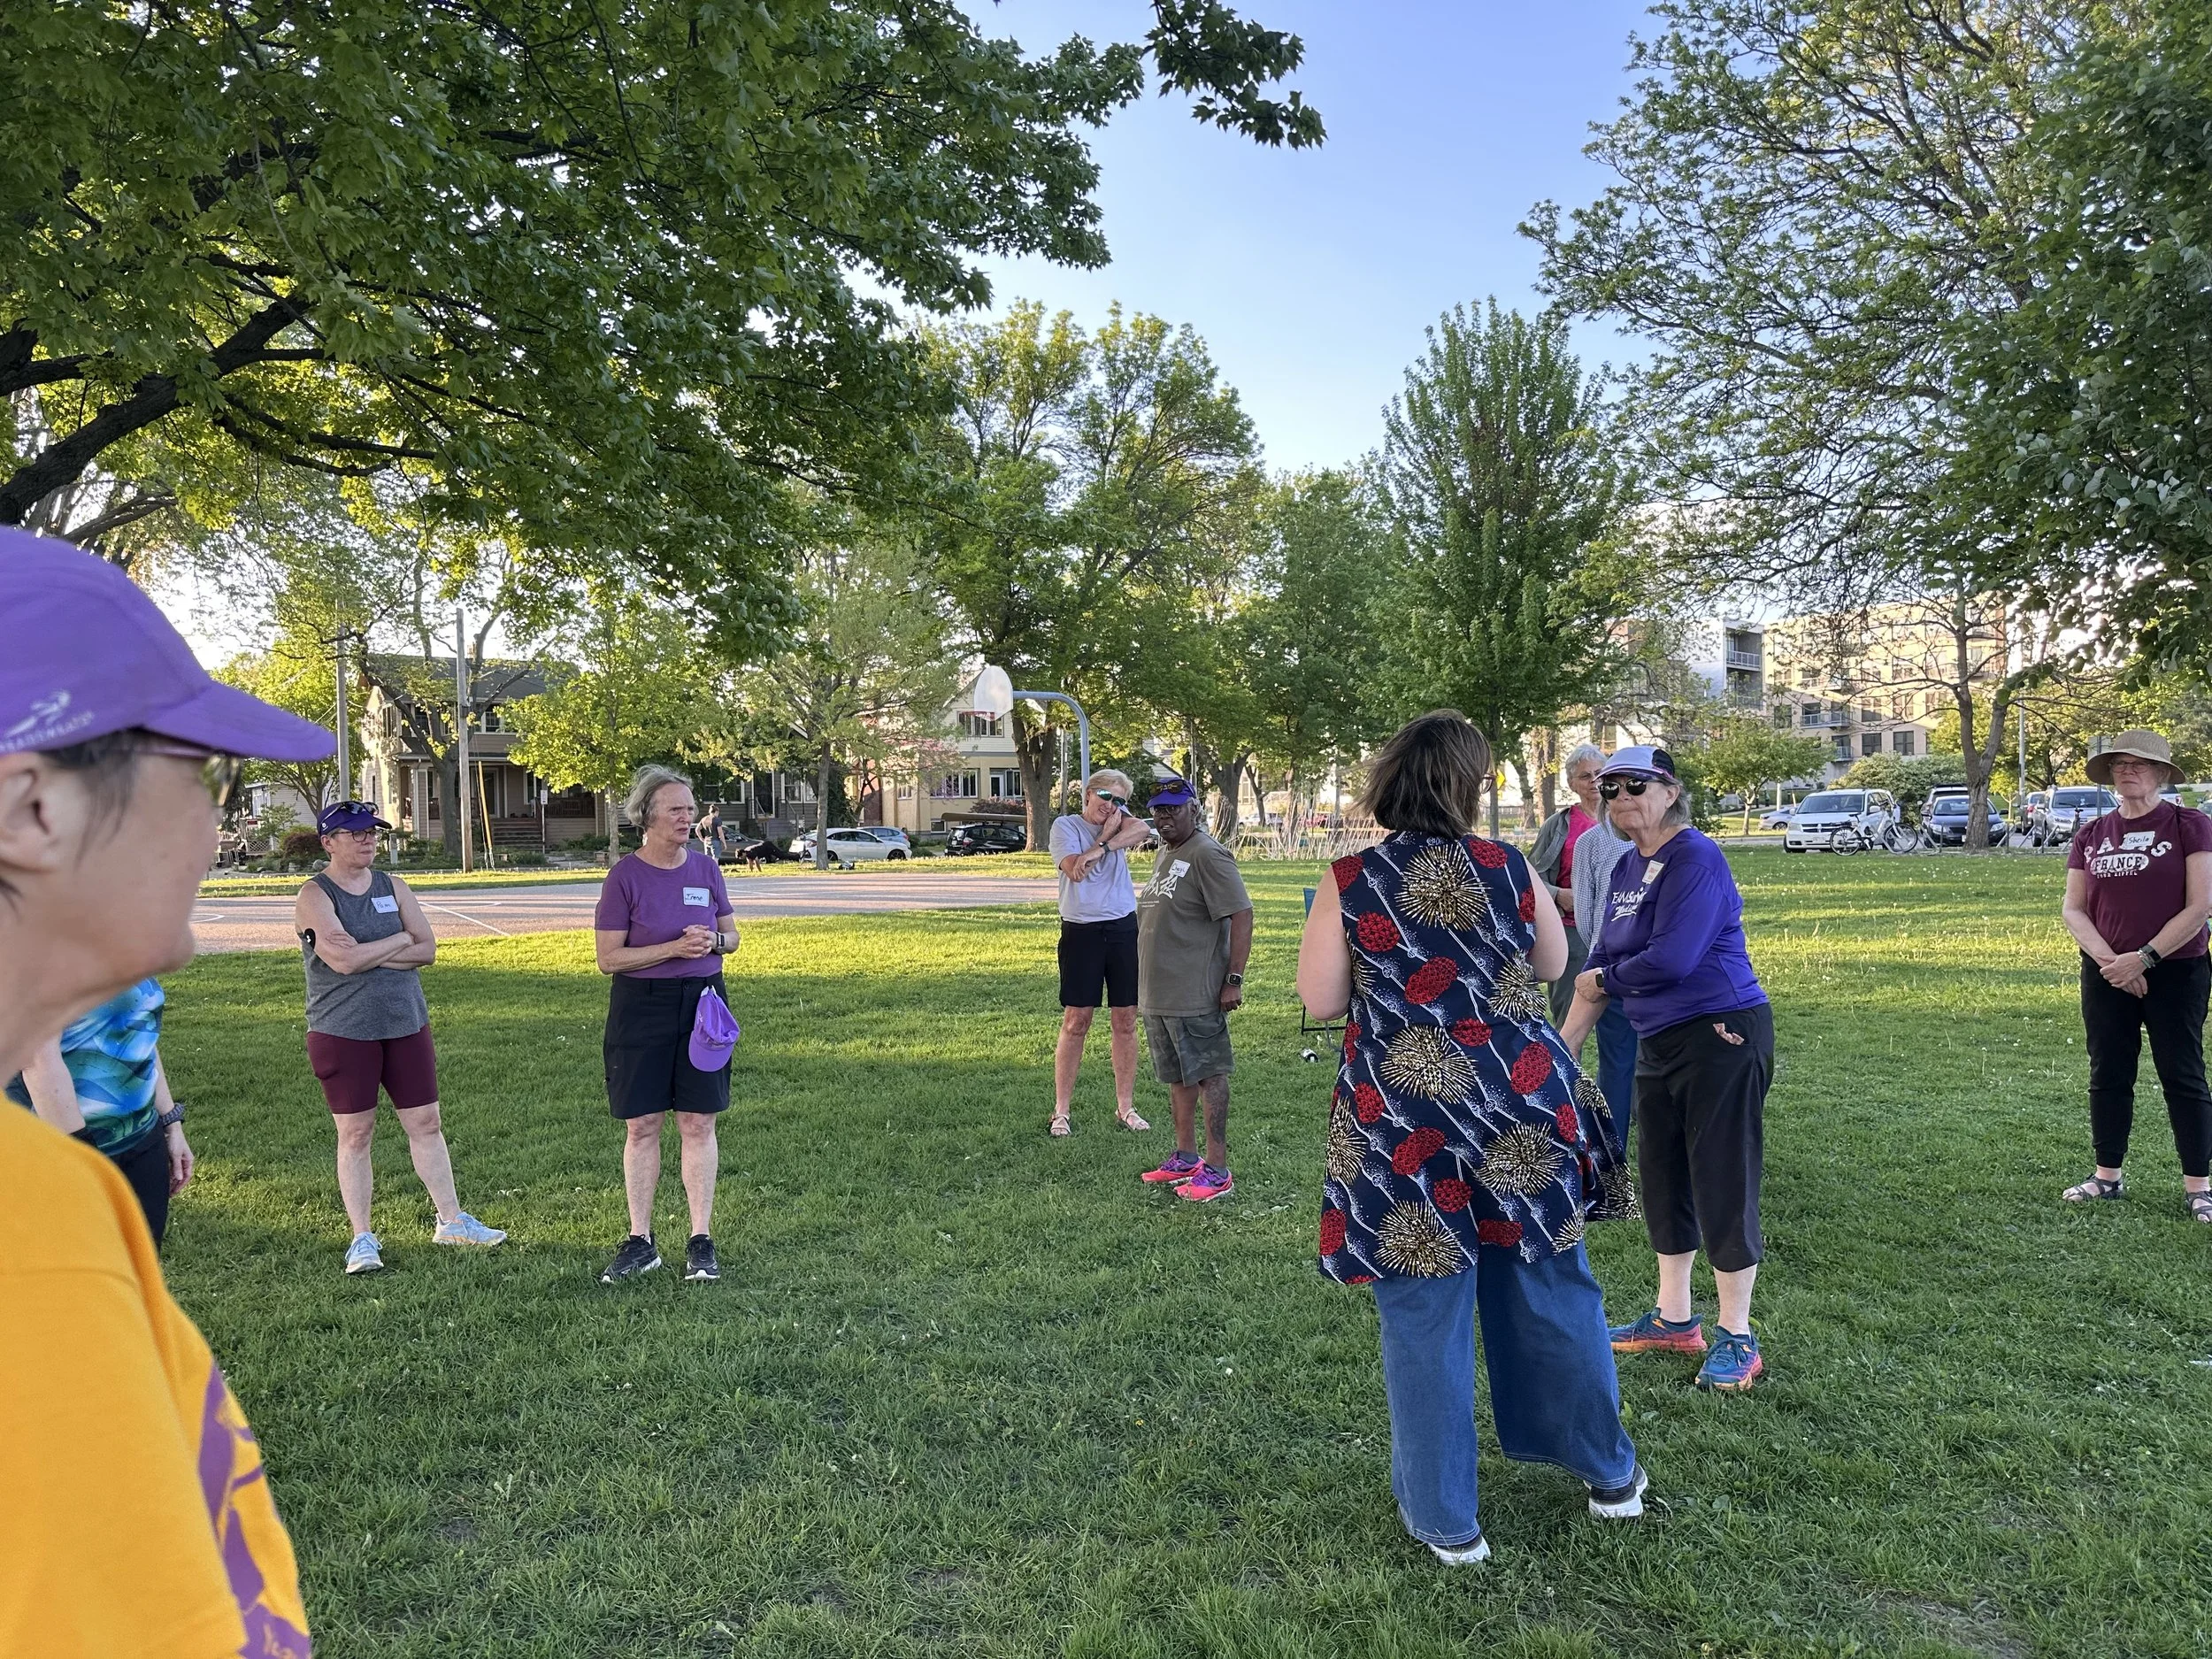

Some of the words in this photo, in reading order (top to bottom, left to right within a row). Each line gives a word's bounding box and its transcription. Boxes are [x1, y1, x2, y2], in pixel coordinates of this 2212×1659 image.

[2128, 835, 2150, 844] Sheila
[2084, 836, 2173, 864] PAS
[2094, 856, 2142, 872] FRANCE
